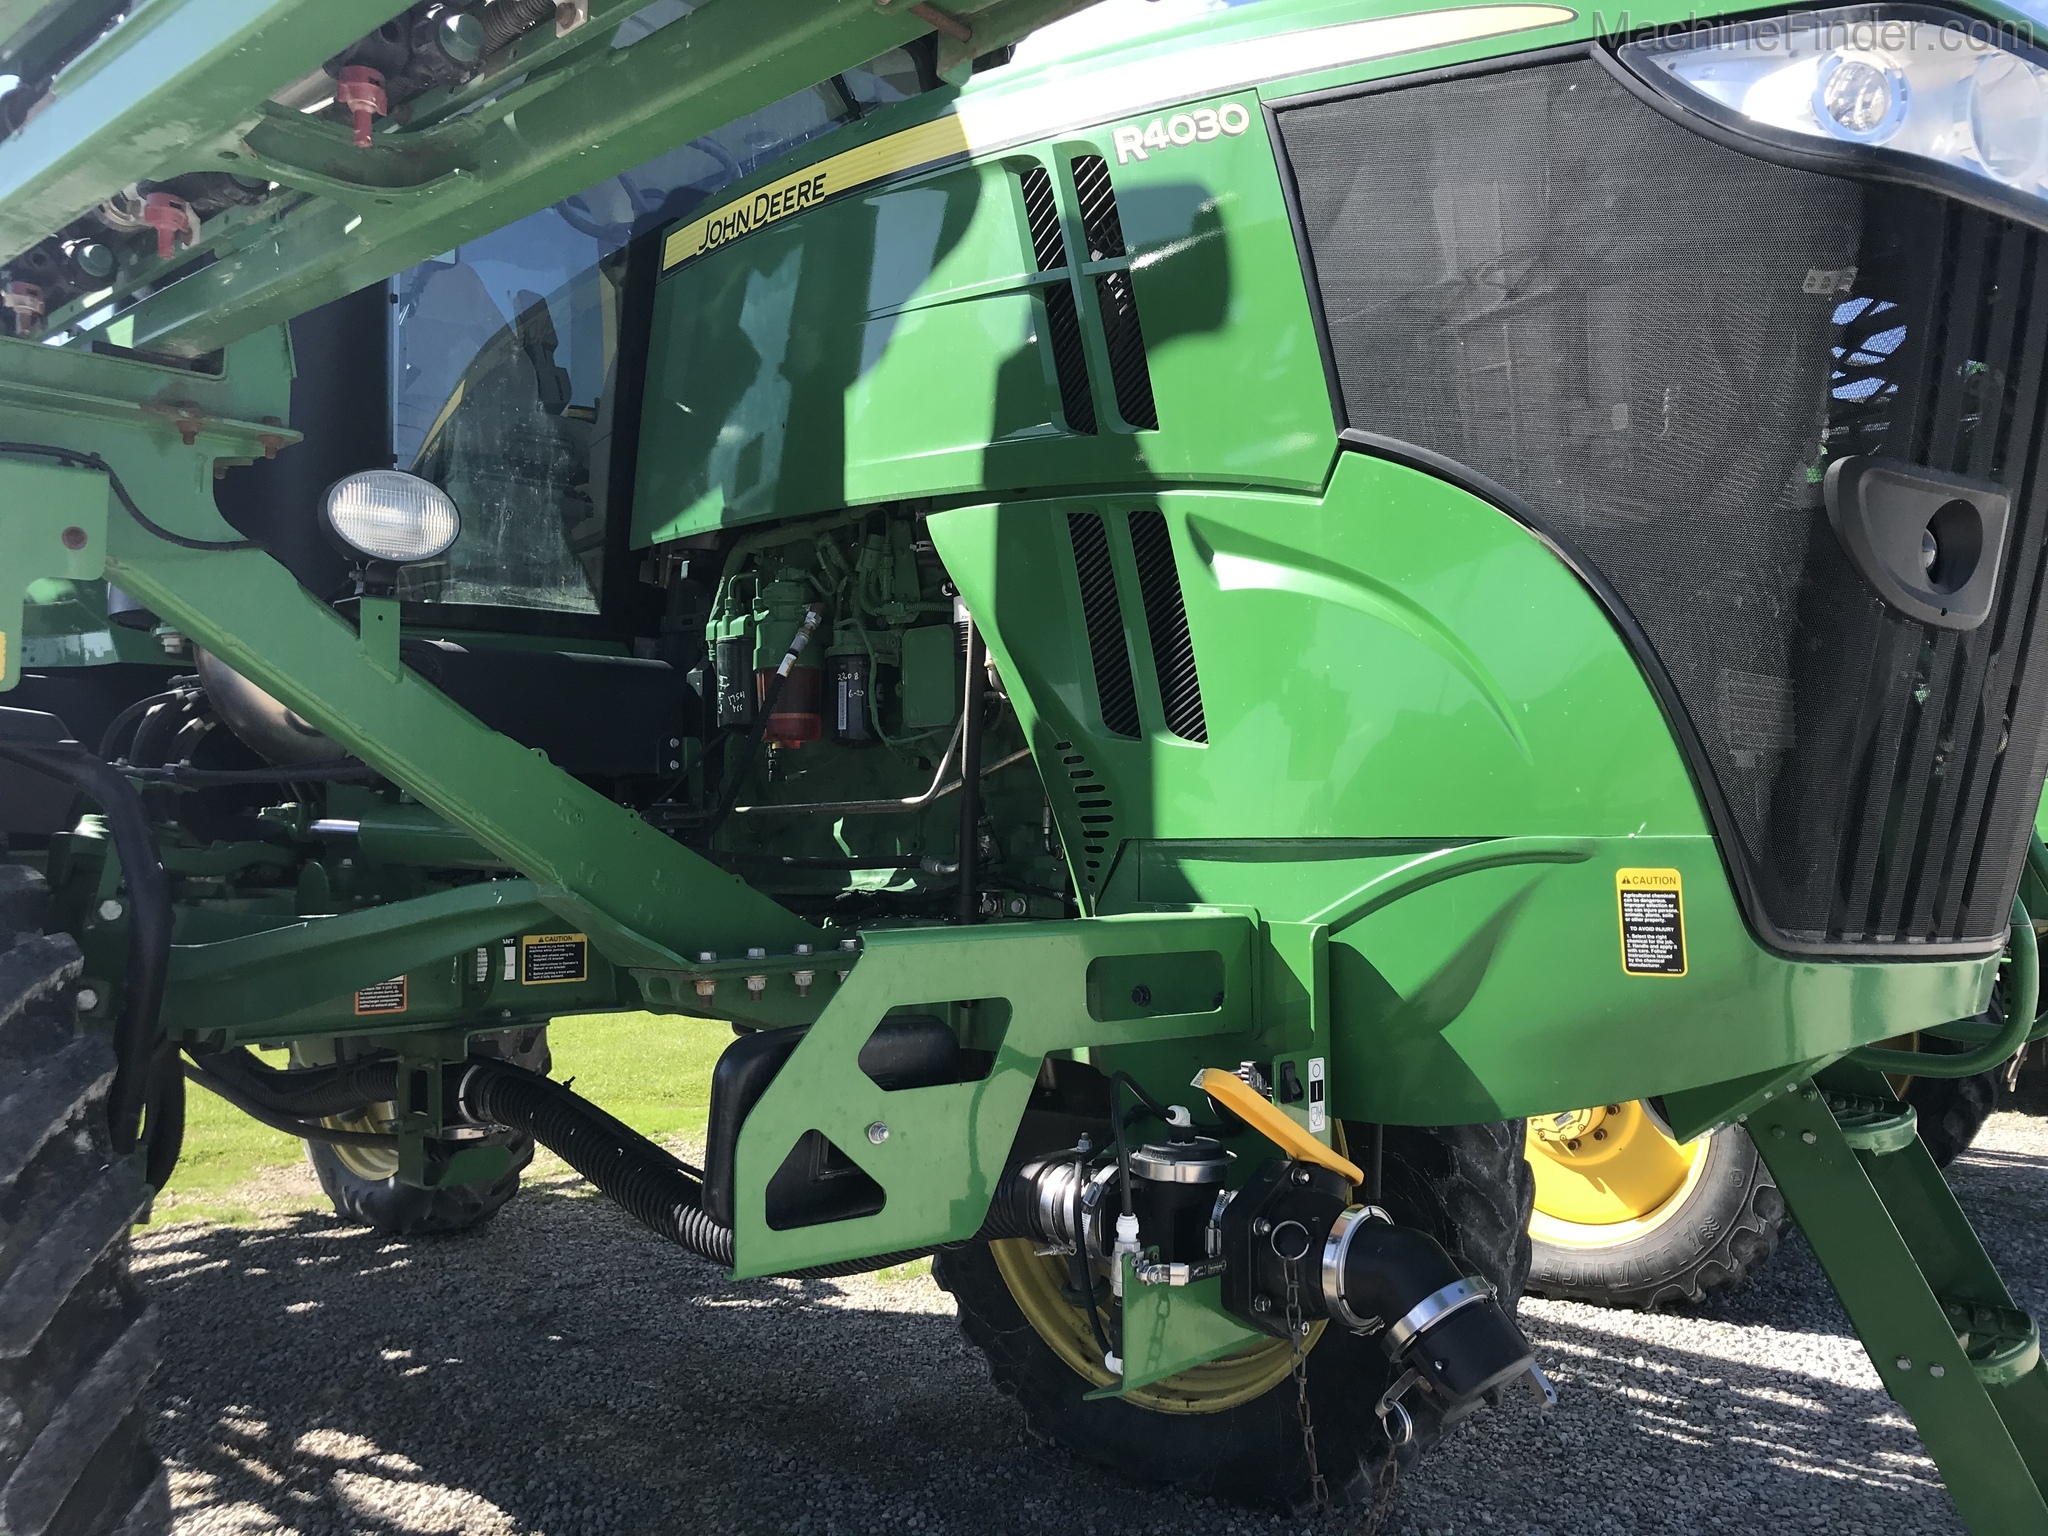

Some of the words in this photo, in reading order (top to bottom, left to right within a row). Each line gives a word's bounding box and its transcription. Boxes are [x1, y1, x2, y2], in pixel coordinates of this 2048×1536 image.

[1111, 102, 1250, 166] R4030
[698, 205, 750, 253] JOHN
[753, 172, 827, 227] DEERE
[1632, 876, 1677, 885] CAUTION
[1540, 1219, 1704, 1287] ALLIANCE
